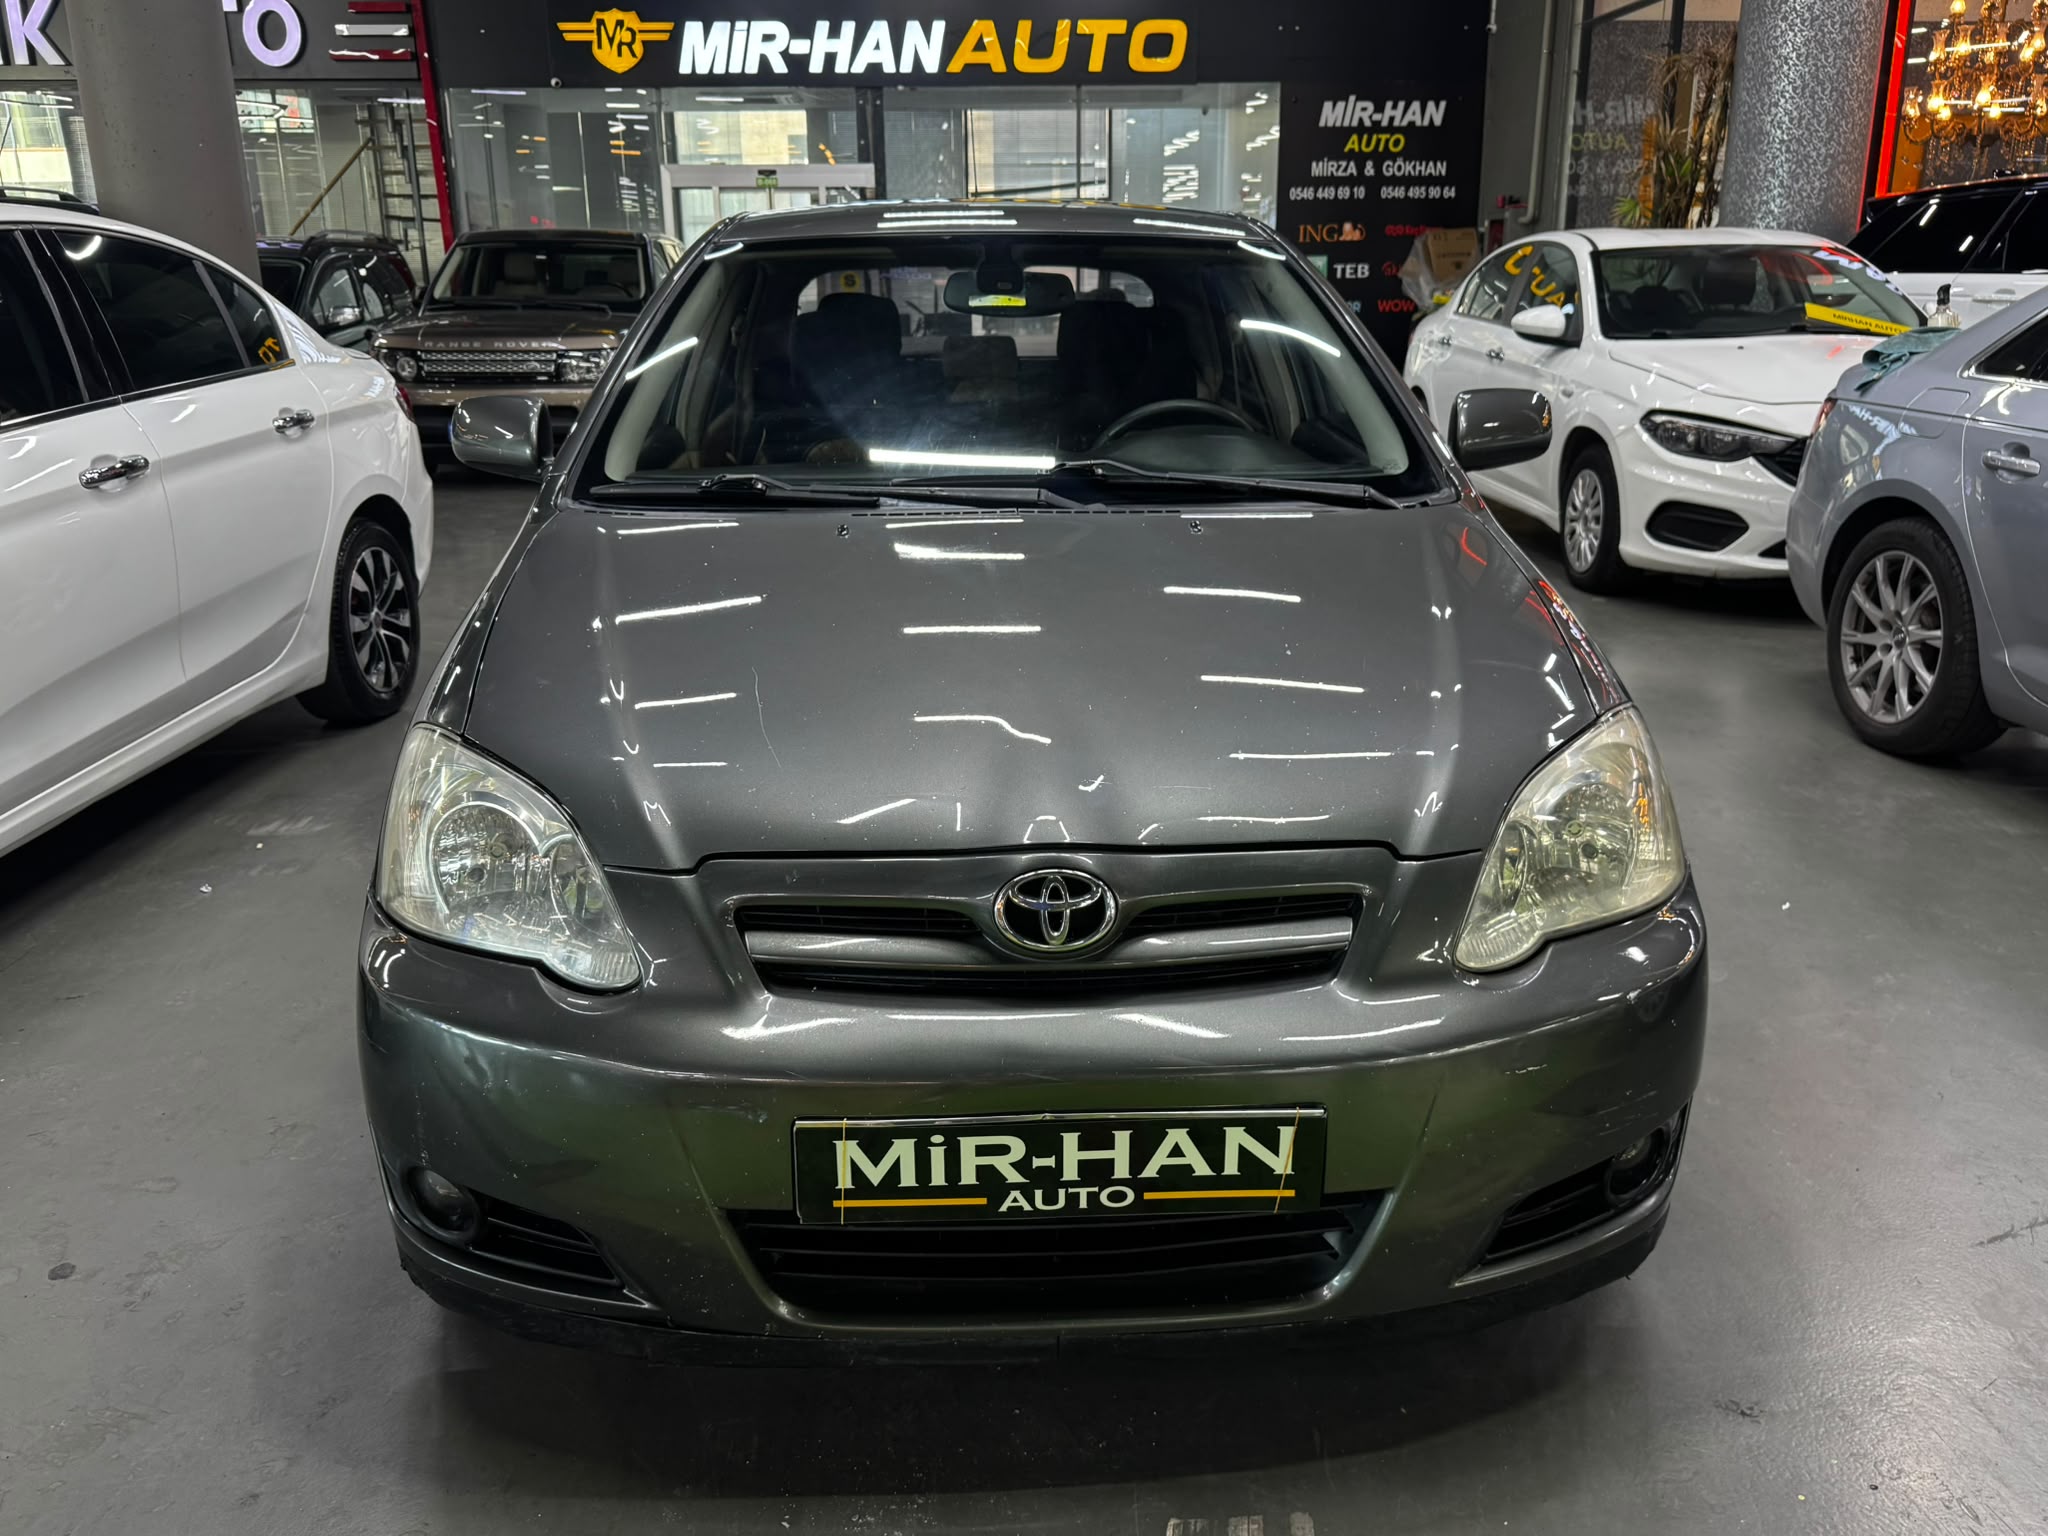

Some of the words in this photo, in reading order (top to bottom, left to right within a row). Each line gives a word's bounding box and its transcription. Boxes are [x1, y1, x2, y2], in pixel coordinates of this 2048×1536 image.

[0, 0, 66, 65] K
[945, 19, 1188, 74] AUTO
[1344, 134, 1405, 152] AUTO
[1364, 160, 1375, 176] &
[1382, 157, 1447, 177] GÖKHAN
[1289, 187, 1314, 200] 0546
[1353, 186, 1365, 199] 10
[1381, 186, 1405, 199] 0546
[1299, 224, 1339, 242] ING
[1334, 263, 1370, 279] TEB
[1377, 300, 1415, 313] WOW
[998, 1185, 1135, 1213] AUTO
